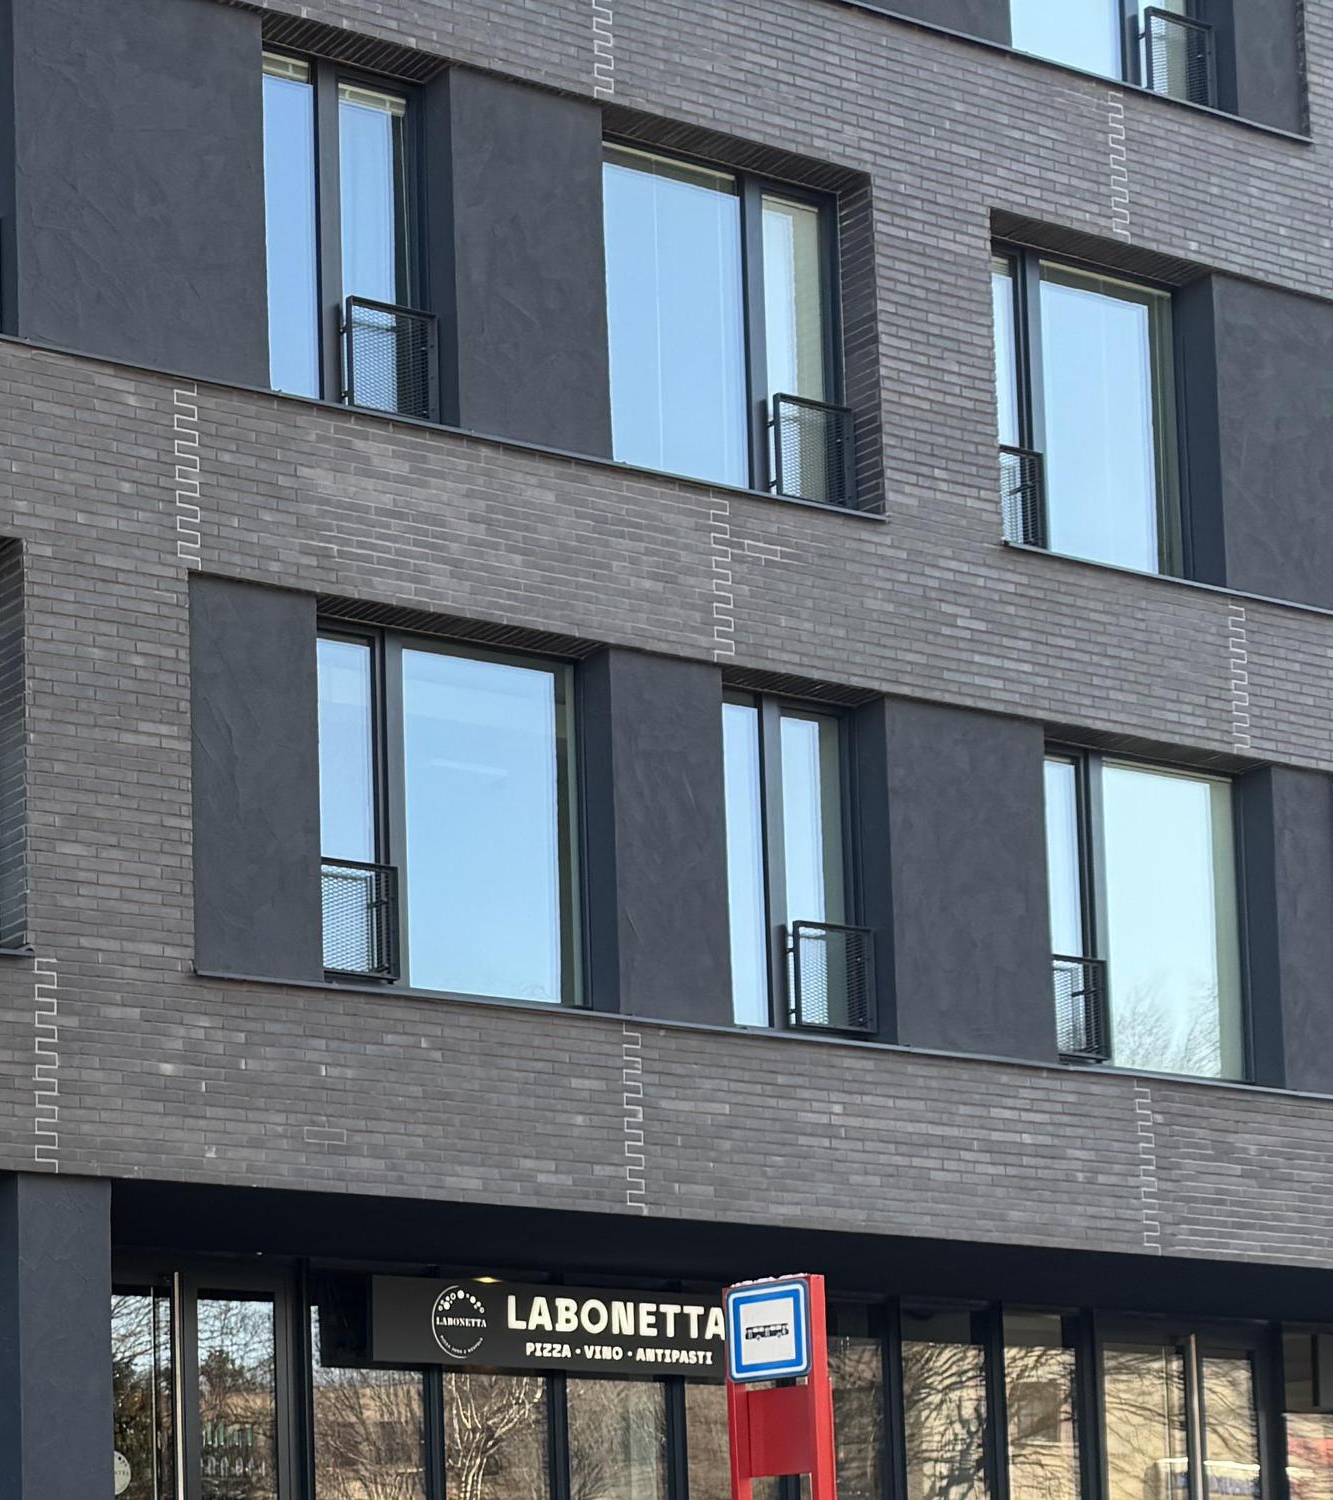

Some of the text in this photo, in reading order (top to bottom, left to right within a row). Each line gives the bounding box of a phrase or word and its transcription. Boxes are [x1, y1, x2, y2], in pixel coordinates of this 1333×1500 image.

[436, 1316, 487, 1328] LABONETTA
[507, 1295, 725, 1340] LABONETTA
[526, 1342, 713, 1365] PIZZA VINO ANTIPASTI
